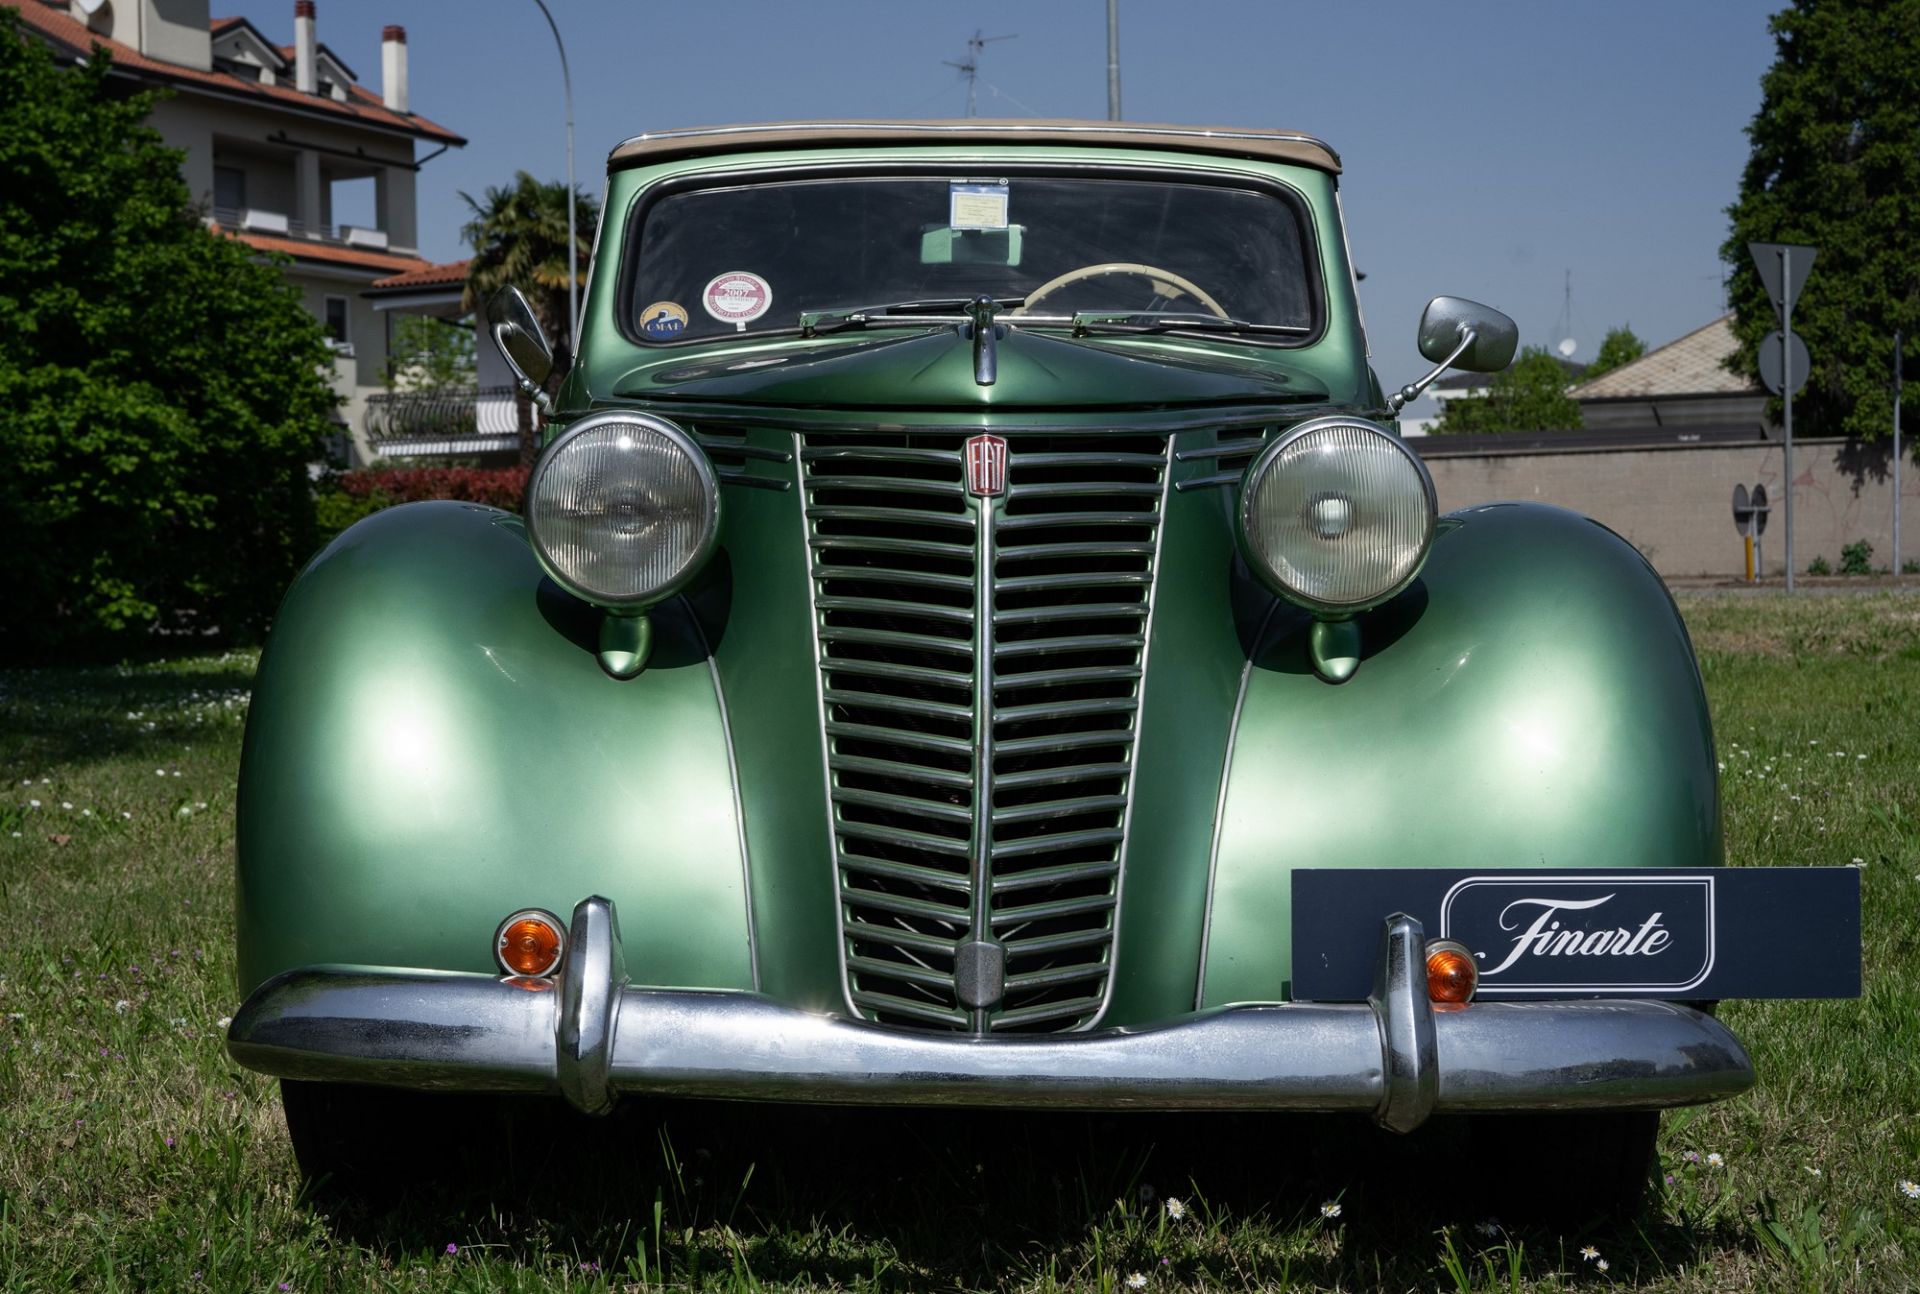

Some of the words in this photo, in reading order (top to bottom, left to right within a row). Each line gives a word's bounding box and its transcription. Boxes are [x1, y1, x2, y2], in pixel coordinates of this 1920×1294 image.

[723, 289, 749, 298] 2007
[971, 441, 1004, 491] FIAT
[1474, 893, 1674, 976] Finarte
